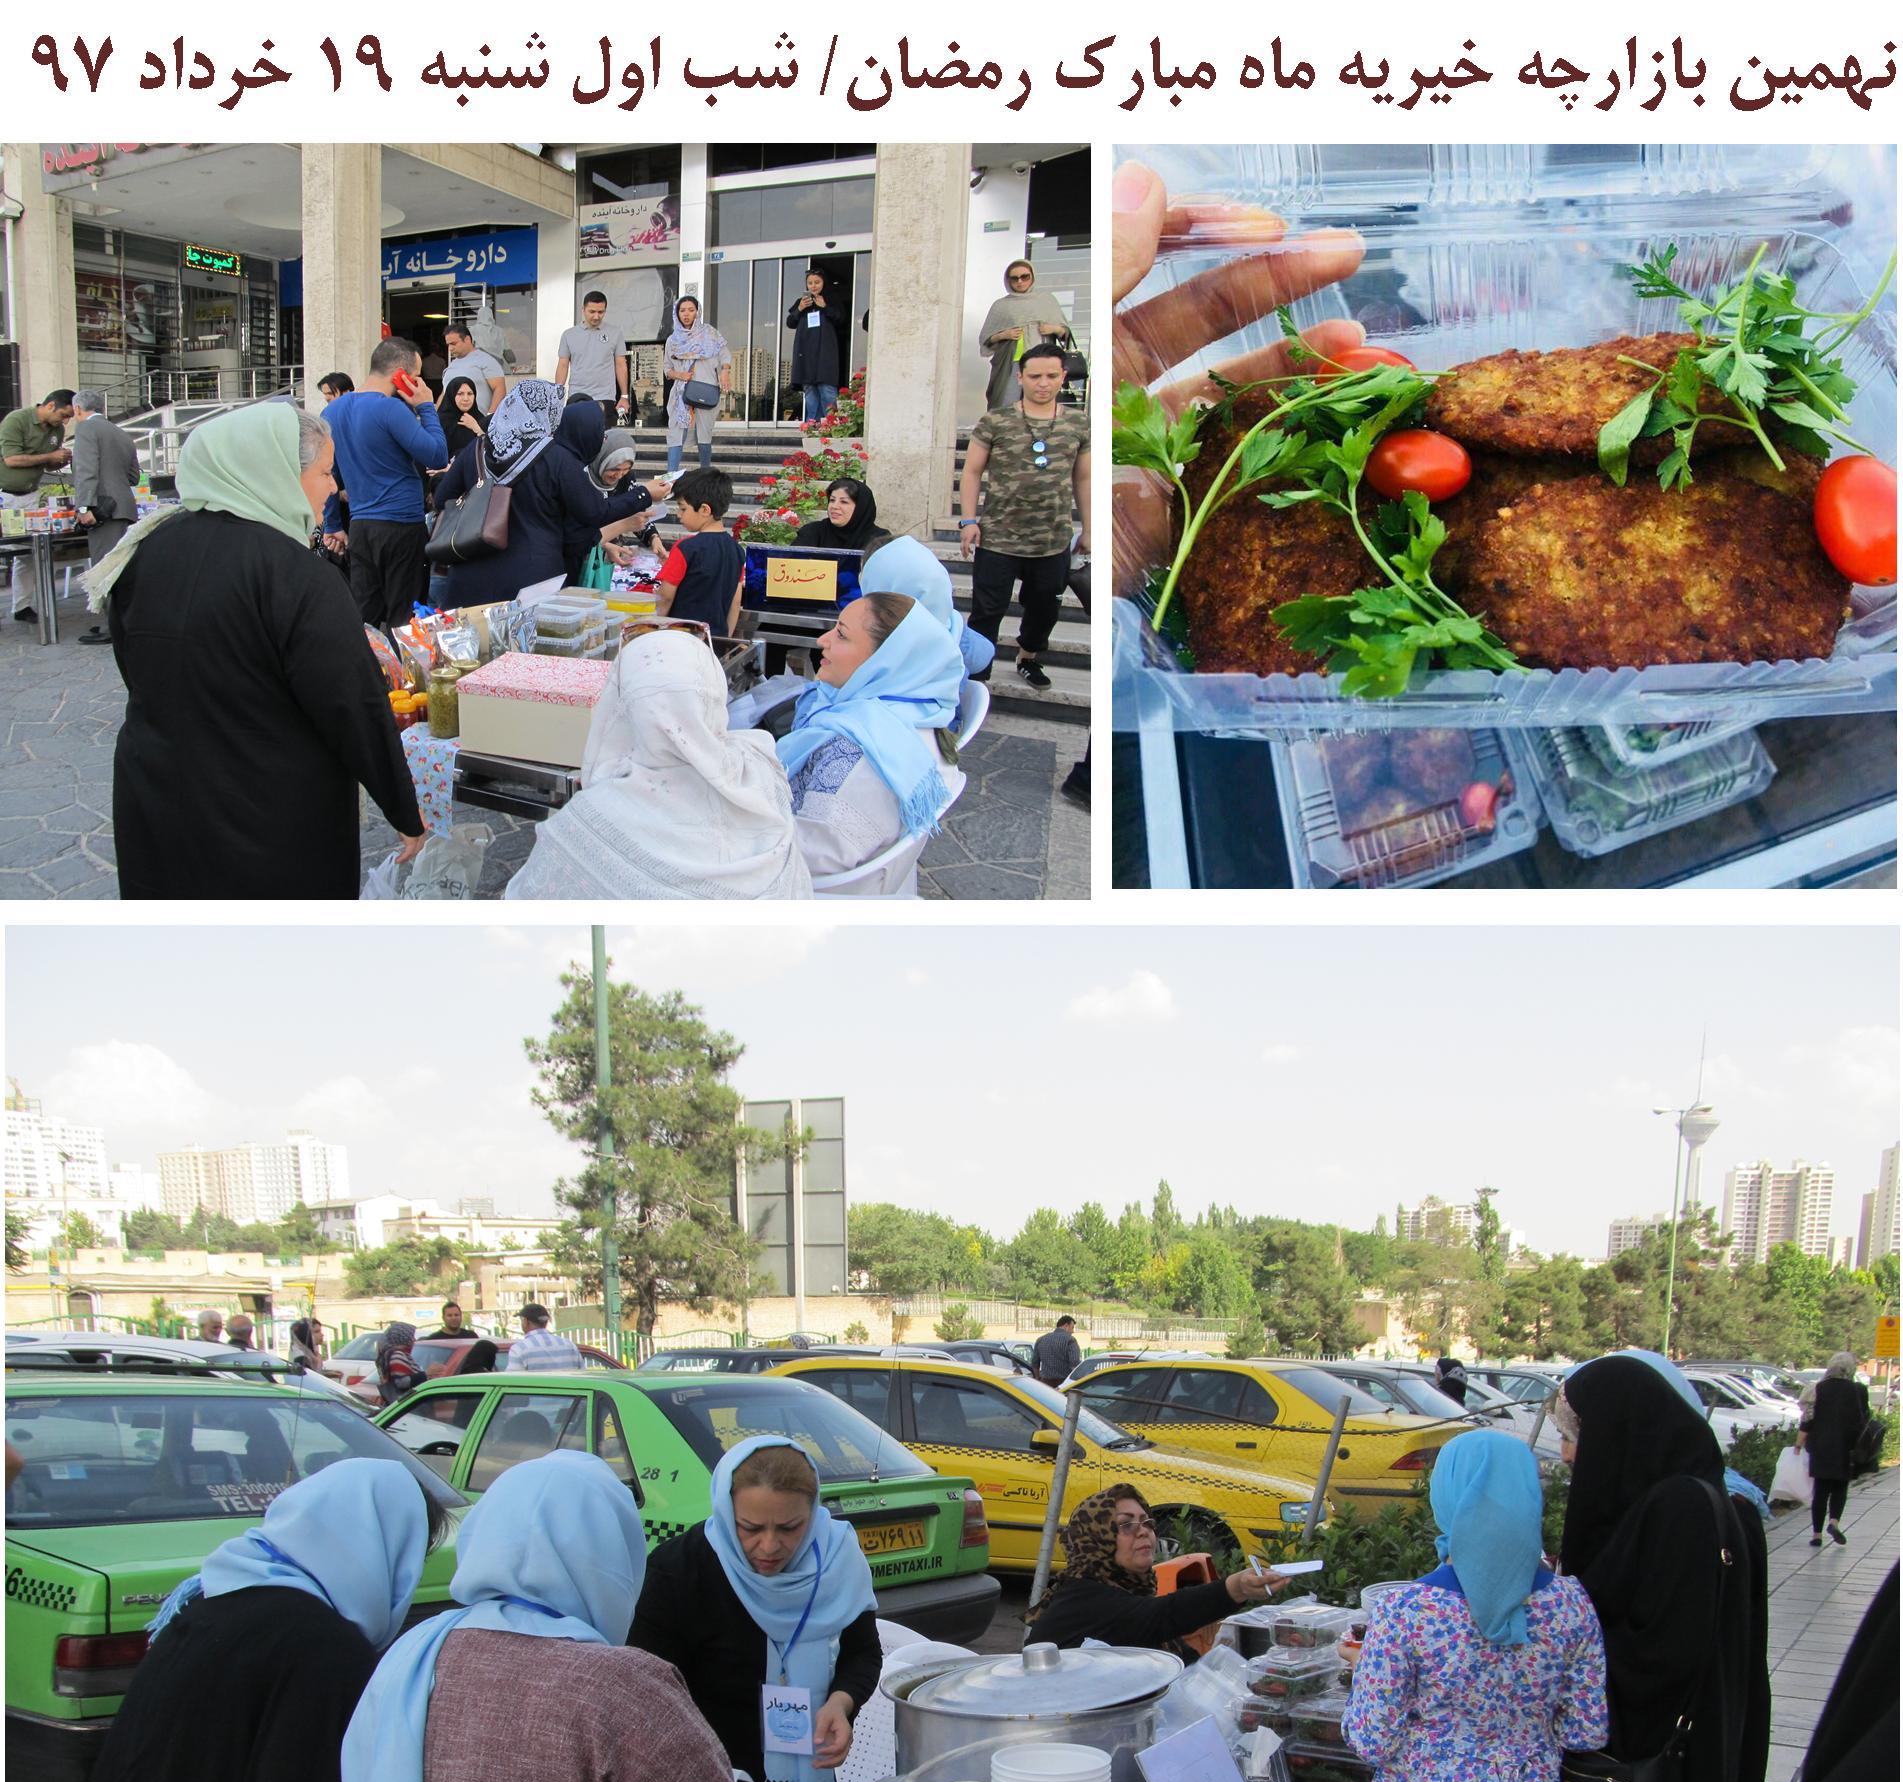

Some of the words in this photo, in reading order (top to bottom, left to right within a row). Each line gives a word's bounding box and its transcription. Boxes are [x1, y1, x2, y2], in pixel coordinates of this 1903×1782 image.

[405, 243, 507, 272] داروخانه
[773, 563, 826, 584] صندوق
[640, 1466, 661, 1480] 28
[670, 1469, 680, 1482] 1
